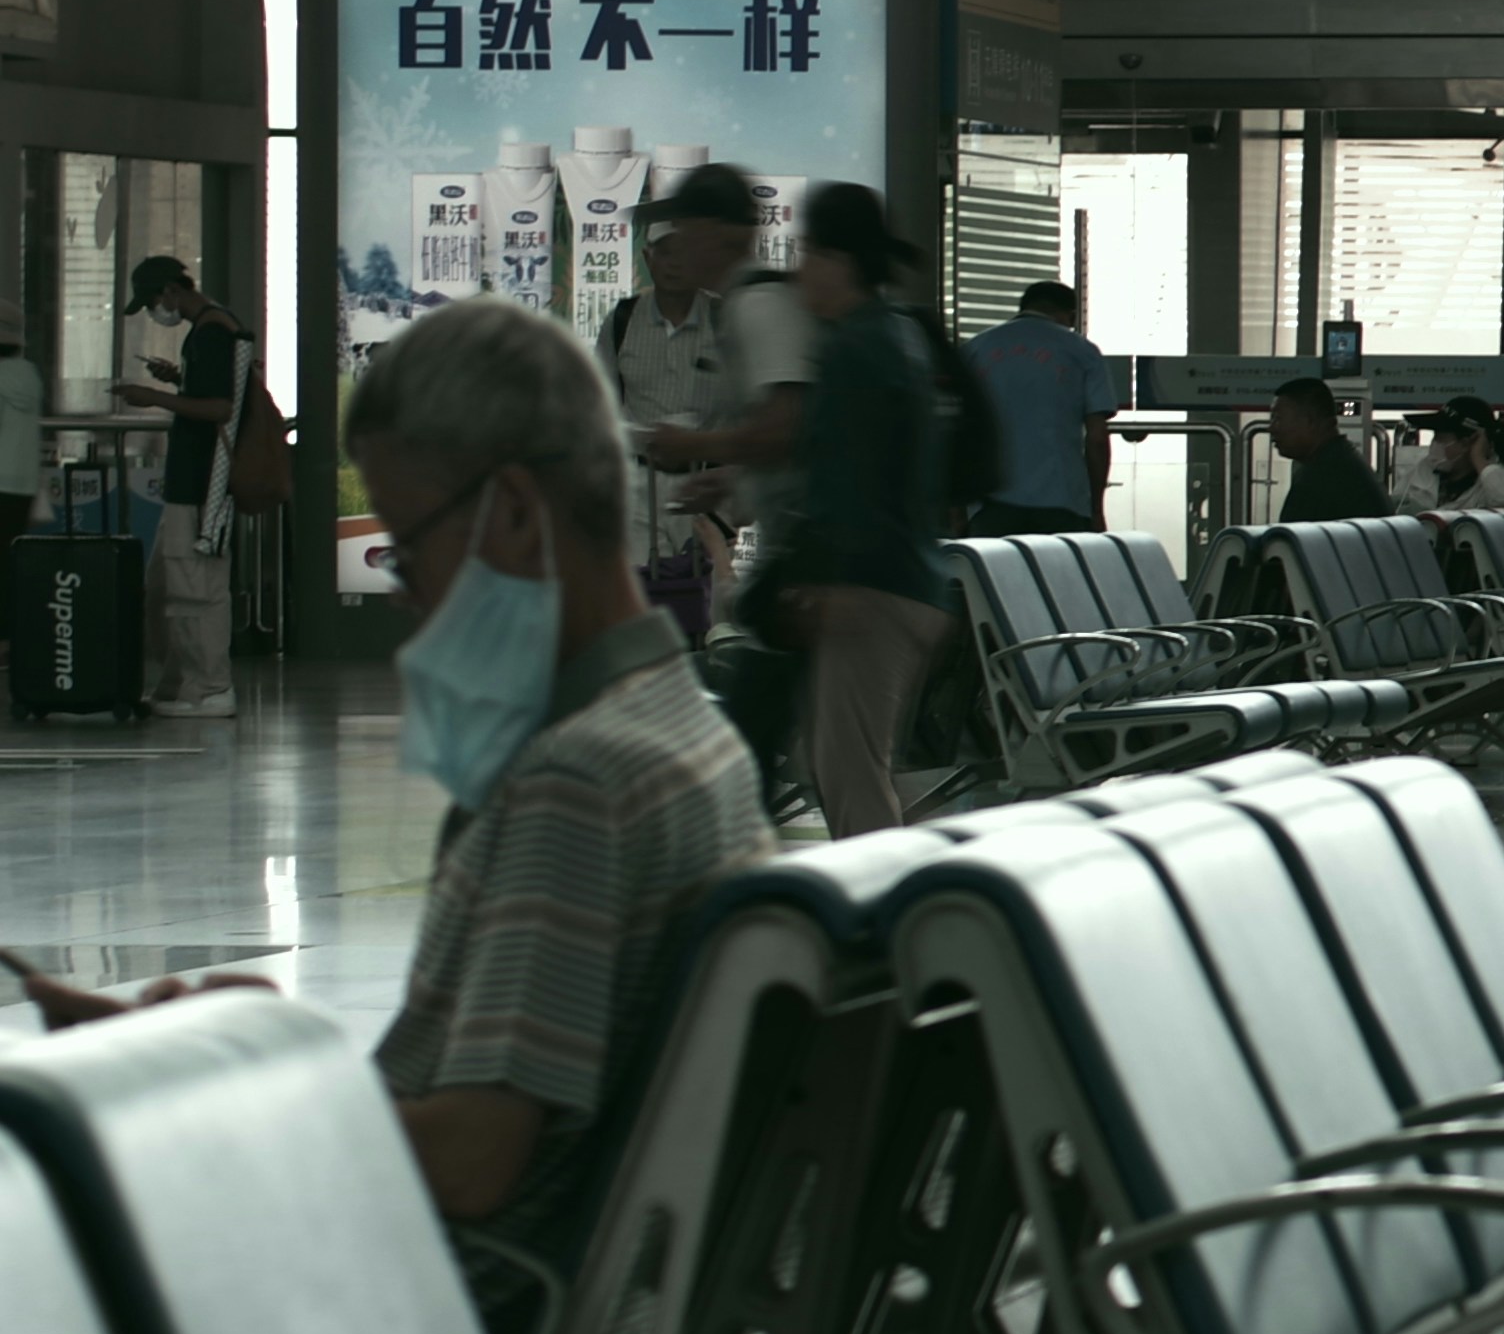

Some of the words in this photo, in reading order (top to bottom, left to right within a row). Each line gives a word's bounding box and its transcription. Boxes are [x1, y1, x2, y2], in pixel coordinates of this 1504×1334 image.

[429, 204, 469, 227] 黑沃
[504, 230, 539, 249] 黑沃
[582, 223, 619, 243] 黑沃
